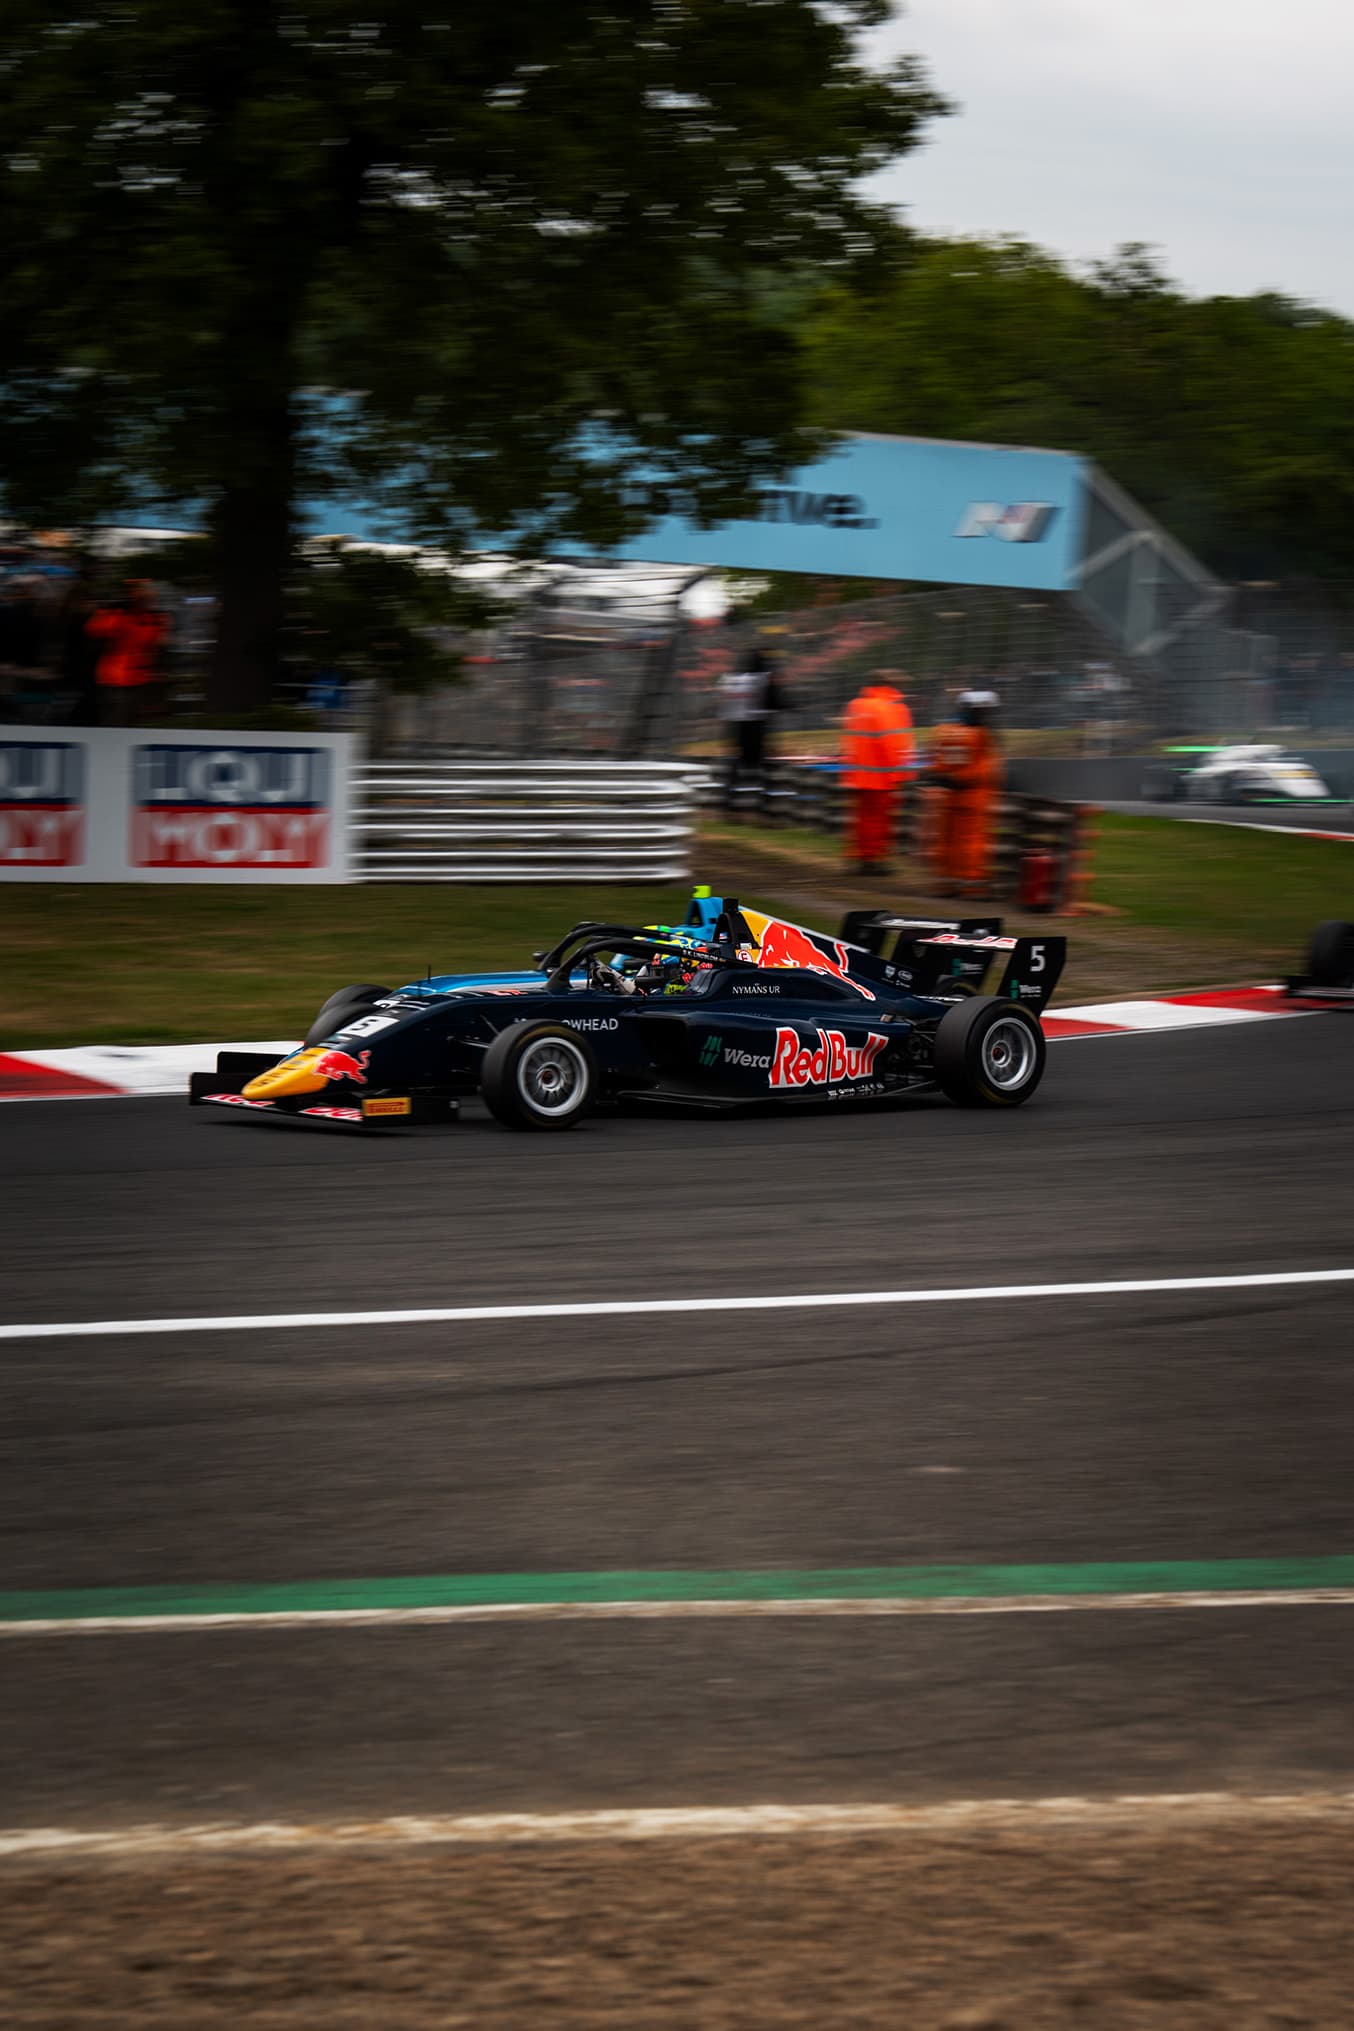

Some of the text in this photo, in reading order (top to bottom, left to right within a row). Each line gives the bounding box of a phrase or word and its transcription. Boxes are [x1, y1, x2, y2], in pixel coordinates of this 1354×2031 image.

[134, 750, 329, 803] LIQUI
[133, 811, 330, 862] MOLY
[1030, 945, 1046, 972] 5
[732, 985, 780, 994] NYMANS UR
[724, 1047, 771, 1068] Wera
